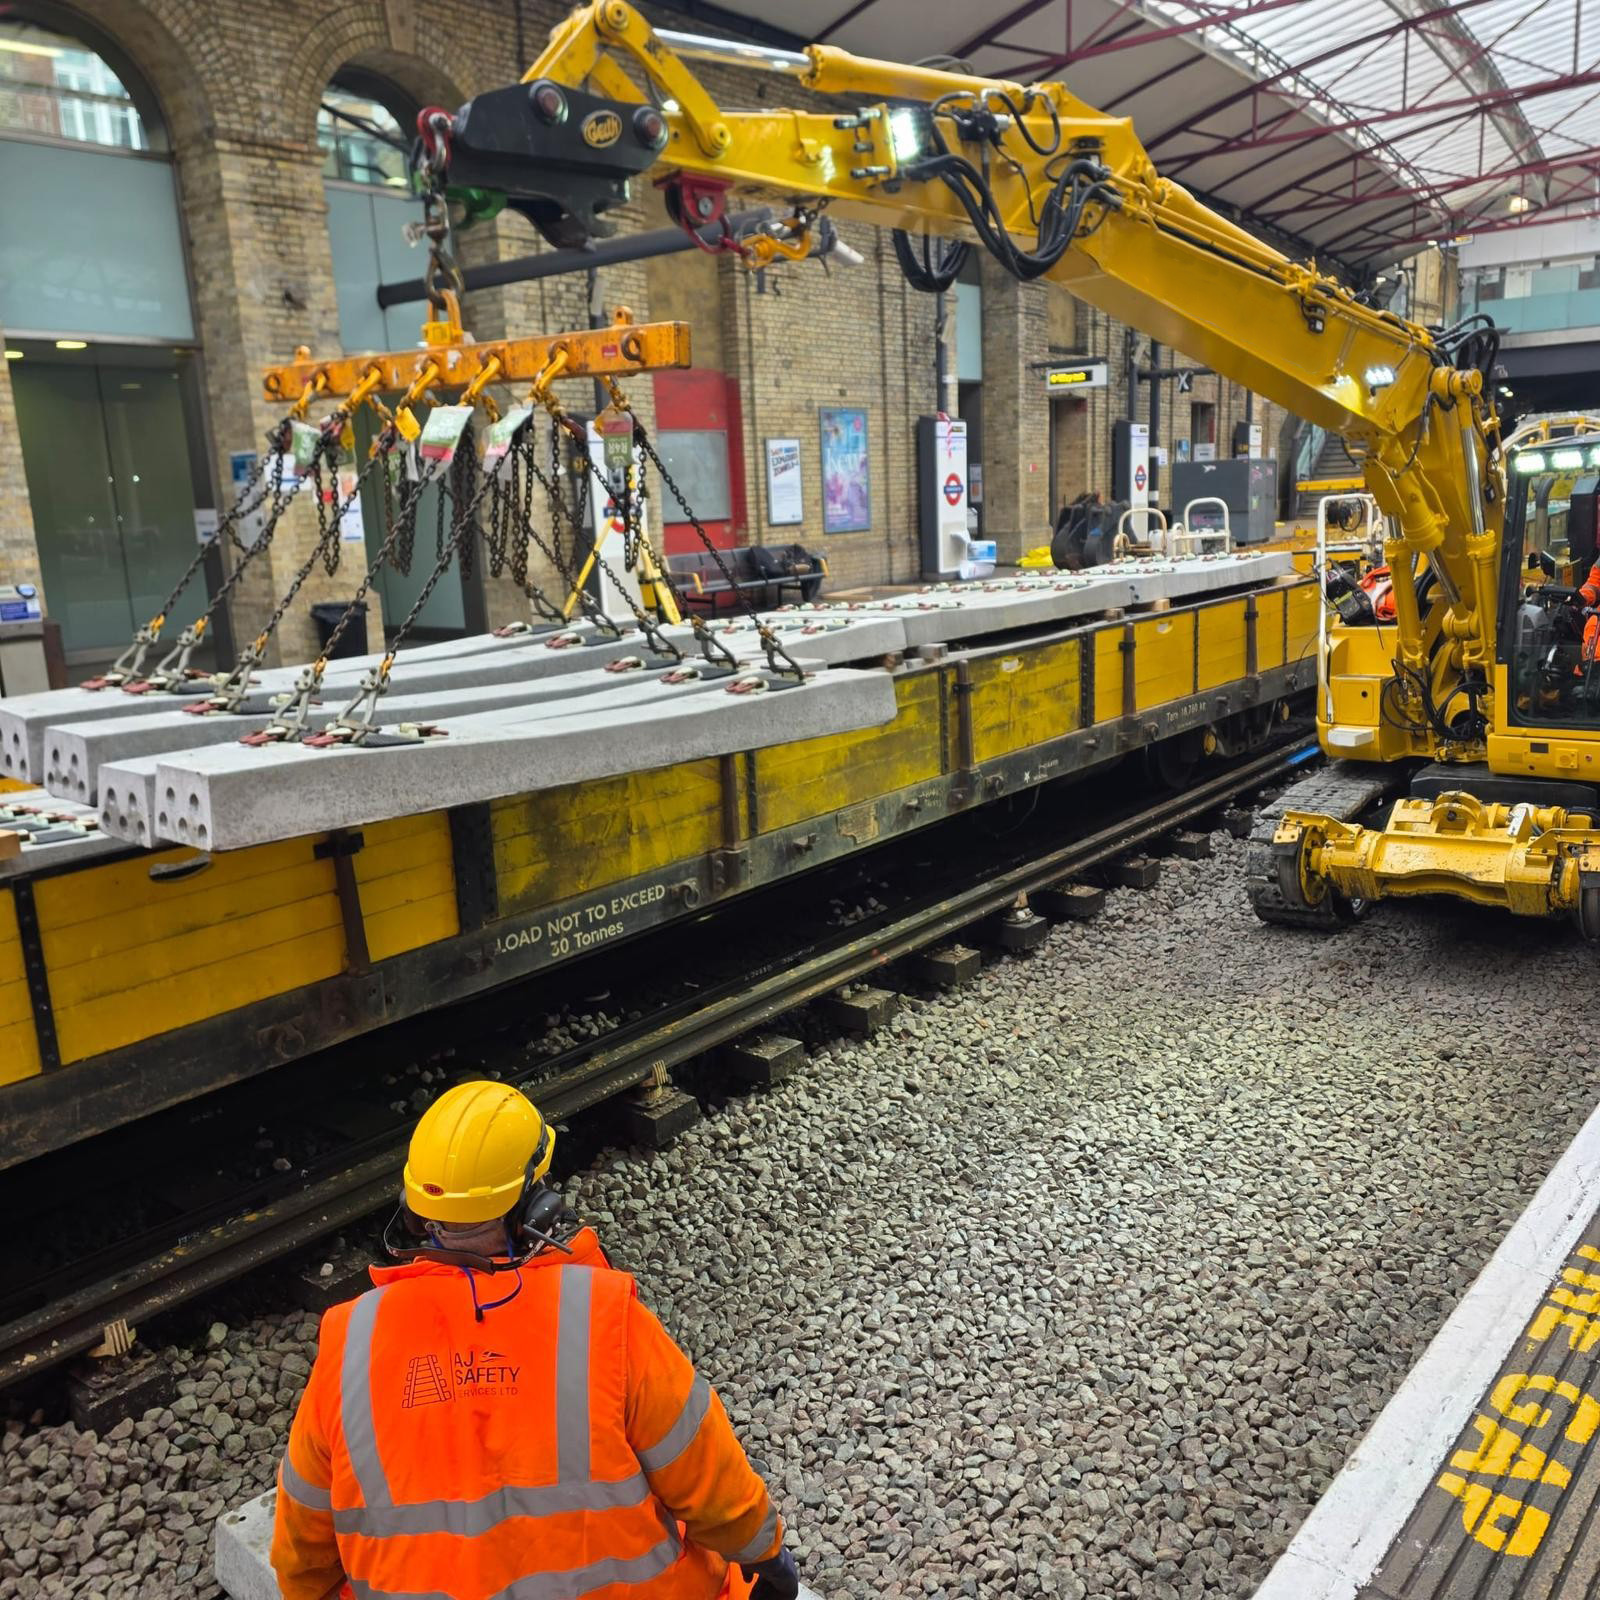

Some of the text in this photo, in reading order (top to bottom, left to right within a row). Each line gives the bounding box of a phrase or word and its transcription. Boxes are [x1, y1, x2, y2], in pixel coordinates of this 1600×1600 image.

[496, 884, 666, 953] LOAD NOT TO EXCEED
[550, 921, 624, 957] 30 Tonnes
[454, 1350, 474, 1368] AJ
[455, 1366, 520, 1386] SAFETY
[500, 1386, 519, 1397] LTD
[1437, 1373, 1600, 1557] GAP
